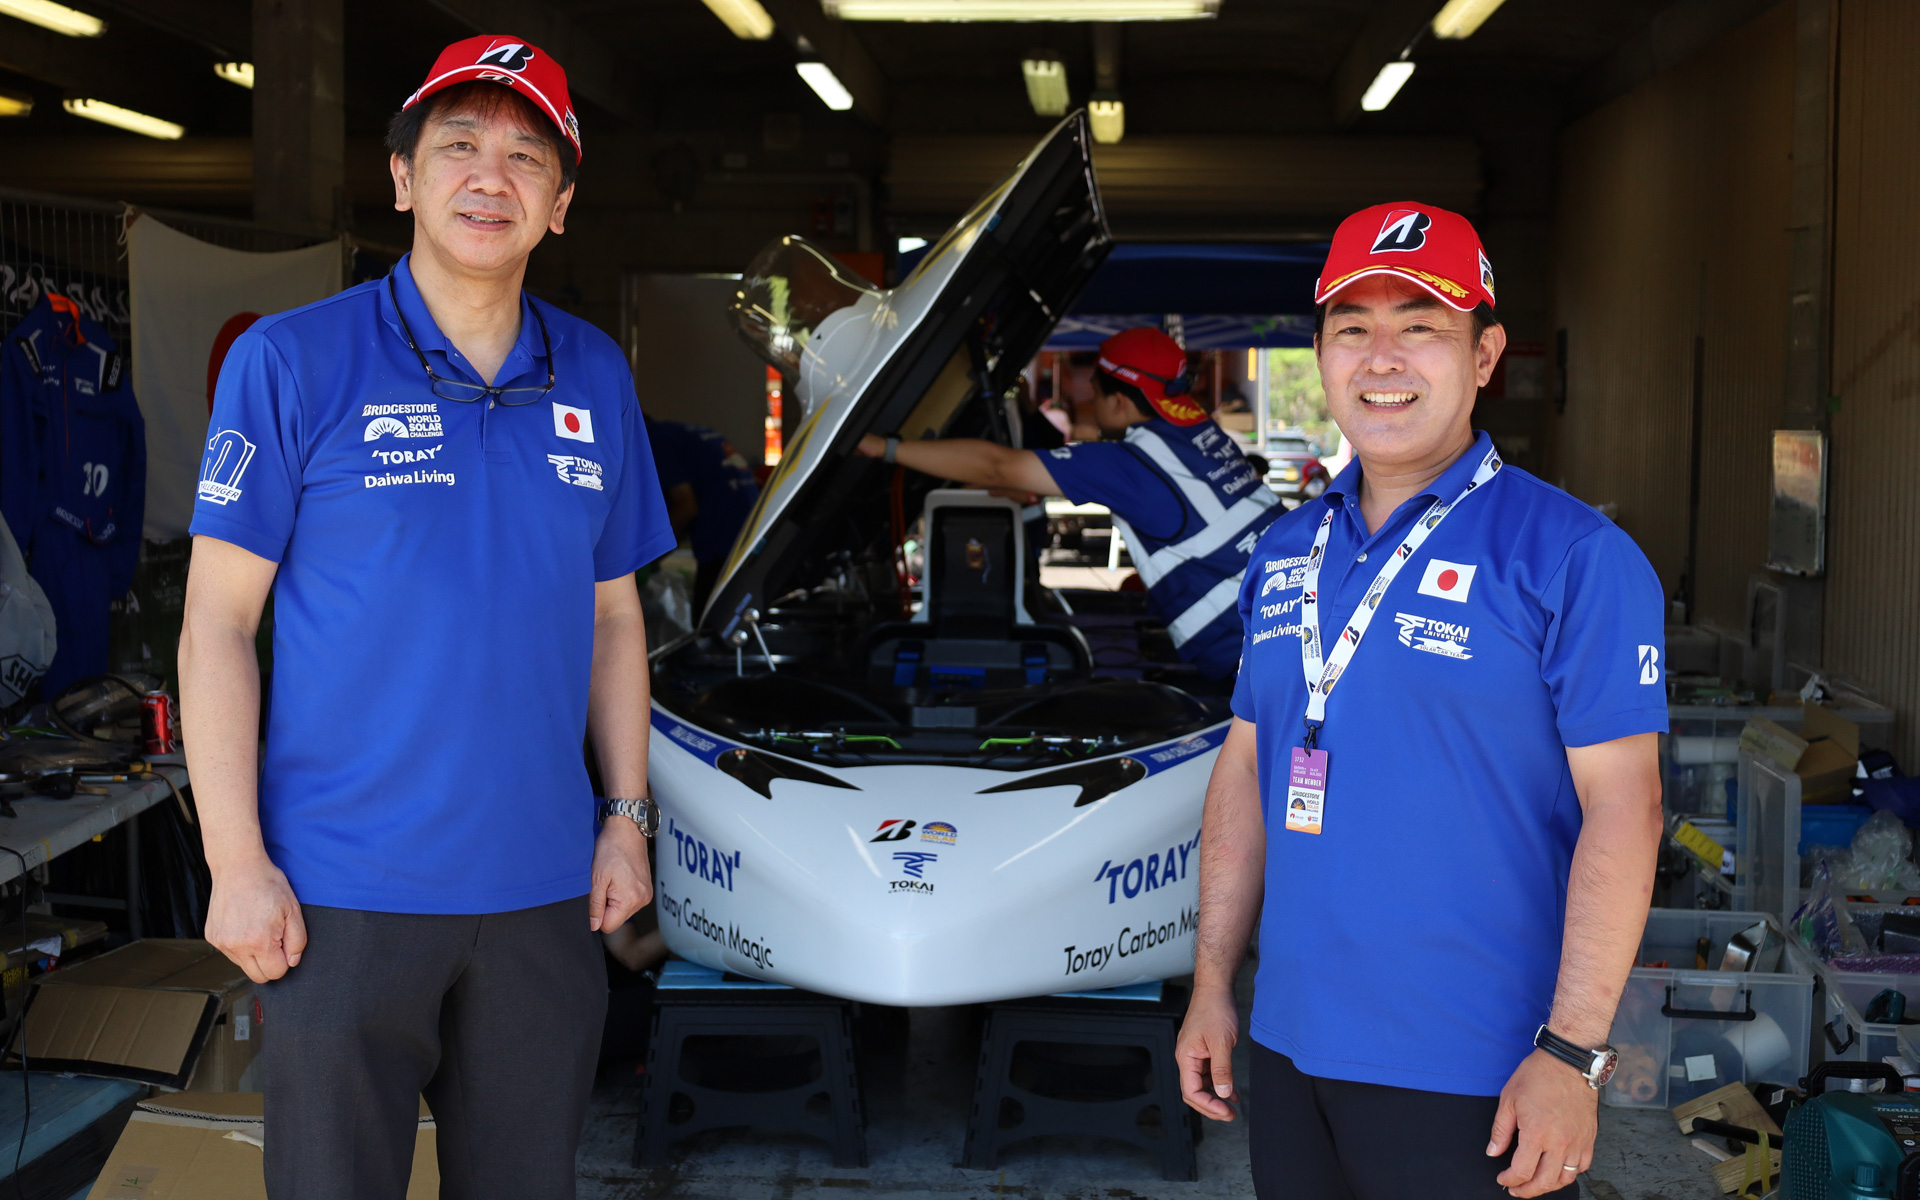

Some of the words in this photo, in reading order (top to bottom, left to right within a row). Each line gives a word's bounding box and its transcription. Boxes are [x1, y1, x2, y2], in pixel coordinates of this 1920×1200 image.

[362, 404, 437, 416] BRIDGESTONE
[407, 415, 441, 423] WORLD
[409, 423, 442, 431] SOLAR
[83, 461, 109, 497] 10
[364, 473, 412, 489] Daiwa
[414, 470, 455, 486] Living
[1265, 556, 1308, 574] BRIDGESTO
[1291, 567, 1307, 576] WOR
[1426, 619, 1470, 638] TOKAI
[1253, 629, 1274, 645] Daiwa
[1423, 629, 1468, 643] UNIVERSITY
[921, 829, 957, 838] WORLD
[921, 834, 956, 843] SOLAR
[889, 880, 934, 892] TOKAI
[661, 881, 682, 927] Toray
[684, 897, 726, 946] Carbon
[729, 920, 774, 969] Magic
[1064, 945, 1114, 975] Toray
[1118, 920, 1176, 958] Carbon
